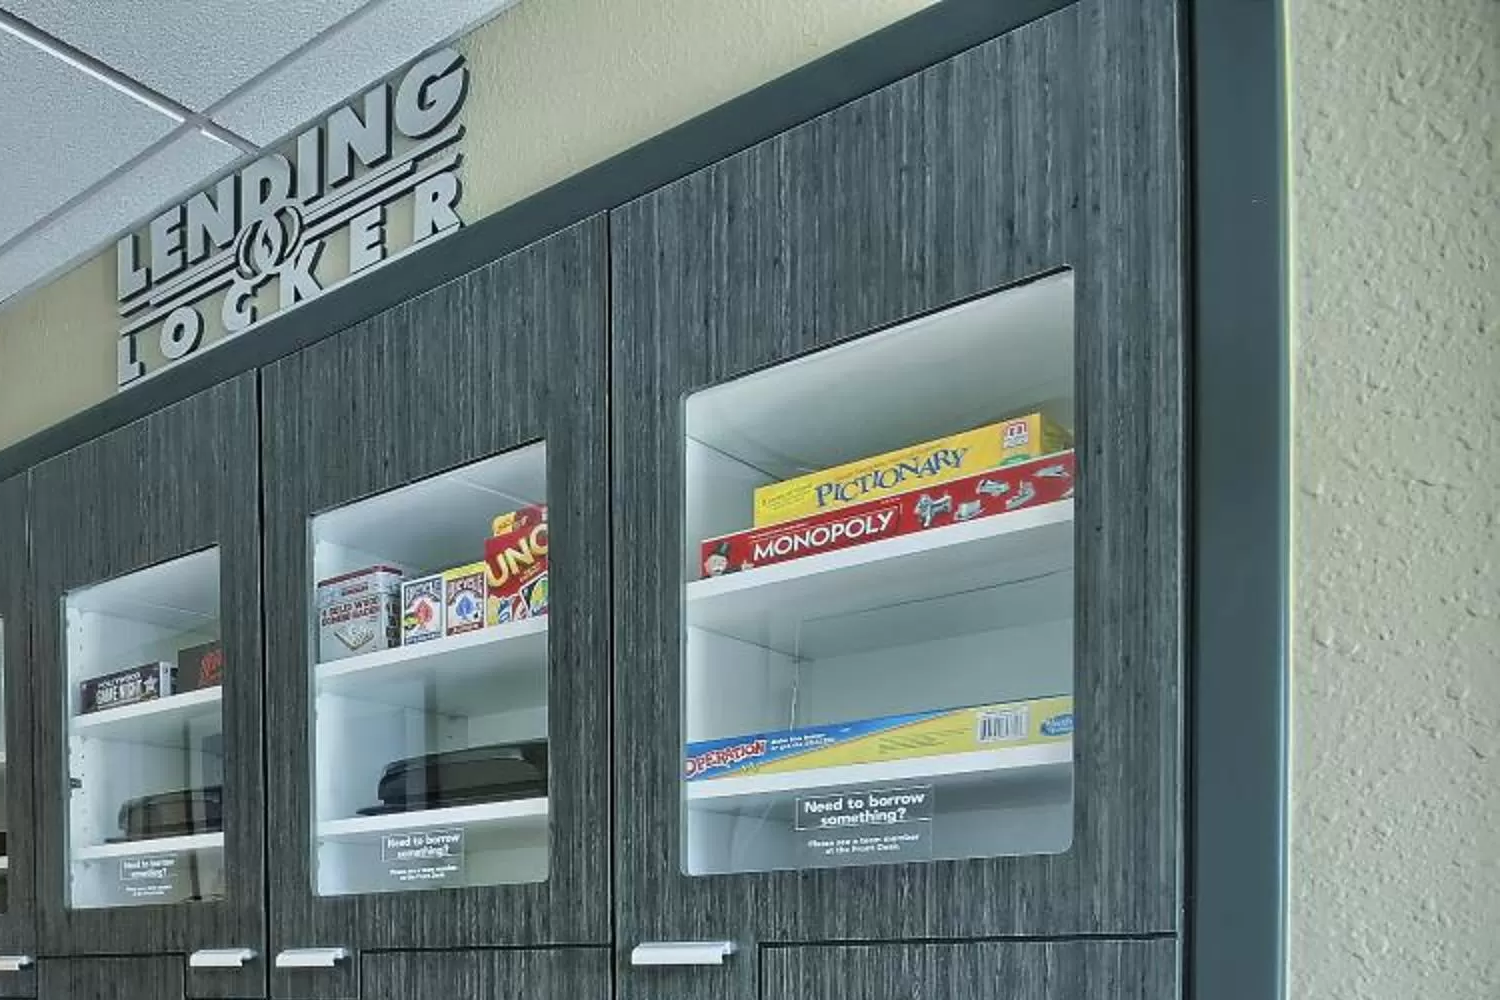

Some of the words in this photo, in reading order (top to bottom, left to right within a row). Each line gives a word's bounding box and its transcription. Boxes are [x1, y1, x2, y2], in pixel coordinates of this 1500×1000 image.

[117, 48, 469, 301] LENDING
[117, 172, 463, 387] LOCKER
[814, 447, 968, 506] PICTIONARY
[484, 523, 548, 588] UNO
[754, 511, 894, 561] MONOPOLY
[684, 739, 768, 778] OPERATION
[804, 798, 843, 813] Need
[847, 798, 865, 809] to
[869, 794, 925, 808] borrow
[821, 807, 907, 827] something?
